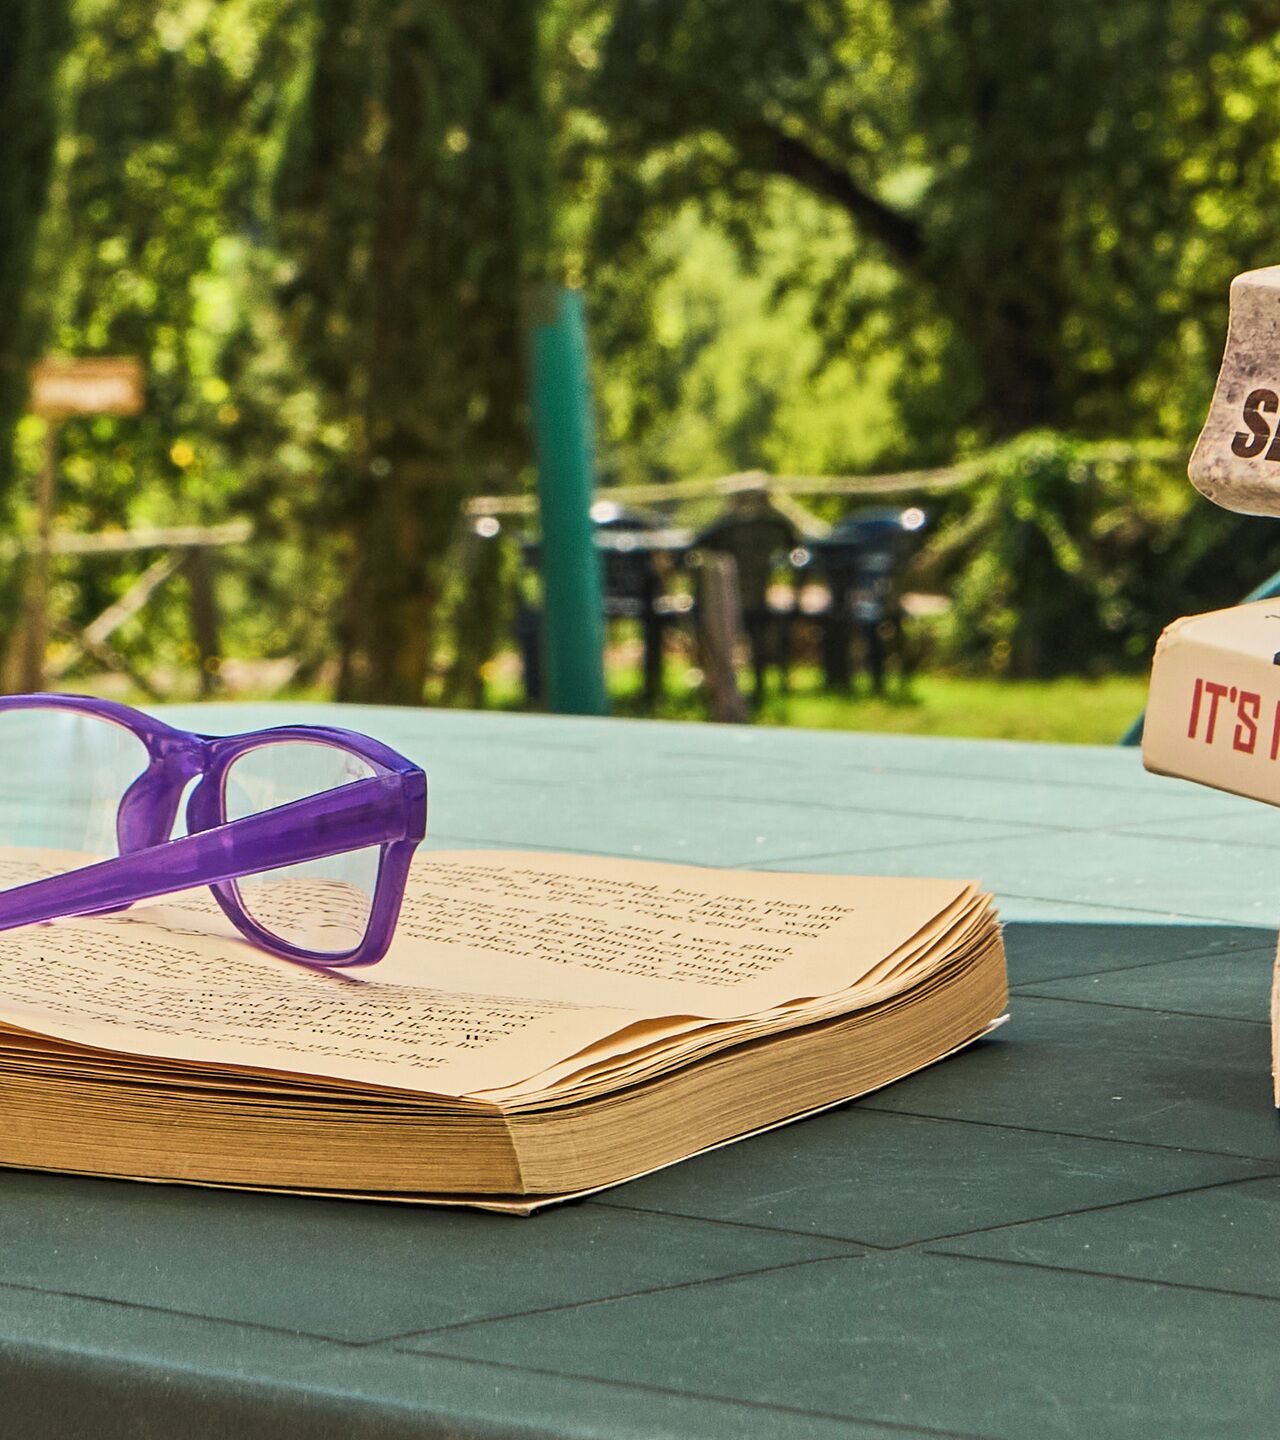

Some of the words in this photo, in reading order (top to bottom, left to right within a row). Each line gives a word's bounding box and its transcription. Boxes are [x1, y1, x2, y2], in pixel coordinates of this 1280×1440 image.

[1187, 678, 1261, 755] IT'S
[548, 890, 595, 899] time
[614, 899, 664, 909] away
[688, 909, 762, 924] talking
[785, 921, 830, 930] with
[587, 886, 624, 895] you
[700, 901, 757, 913] Jack!
[806, 914, 842, 922] not
[672, 888, 706, 898] but
[715, 896, 756, 904] just
[764, 900, 811, 910] then
[821, 905, 854, 913] the
[421, 892, 496, 909] leaving
[620, 926, 664, 936] and
[692, 937, 730, 946] was
[635, 909, 696, 923] rope's
[752, 927, 818, 938] across
[406, 932, 461, 944] settle
[467, 943, 532, 956] about
[539, 954, 574, 966] my
[427, 910, 465, 918] did
[499, 921, 527, 930] my
[531, 928, 692, 958] grandmother,
[694, 954, 729, 965] but
[738, 962, 772, 971] the
[498, 930, 565, 945] comes
[573, 942, 626, 956] from
[634, 954, 662, 963] my
[533, 943, 622, 963] beyond
[627, 962, 660, 971] my
[581, 926, 650, 943] visions
[658, 941, 716, 953] came
[752, 954, 785, 962] me
[242, 1010, 312, 1019] where
[394, 1021, 429, 1029] He
[437, 1026, 513, 1036] comes
[274, 1004, 322, 1012] had
[330, 1009, 395, 1018] much
[407, 1014, 490, 1025] chance
[358, 1002, 412, 1011] been
[423, 1007, 474, 1016] kept
[486, 1011, 541, 1020] busy
[312, 1029, 422, 1045] whipping
[455, 1041, 485, 1049] he
